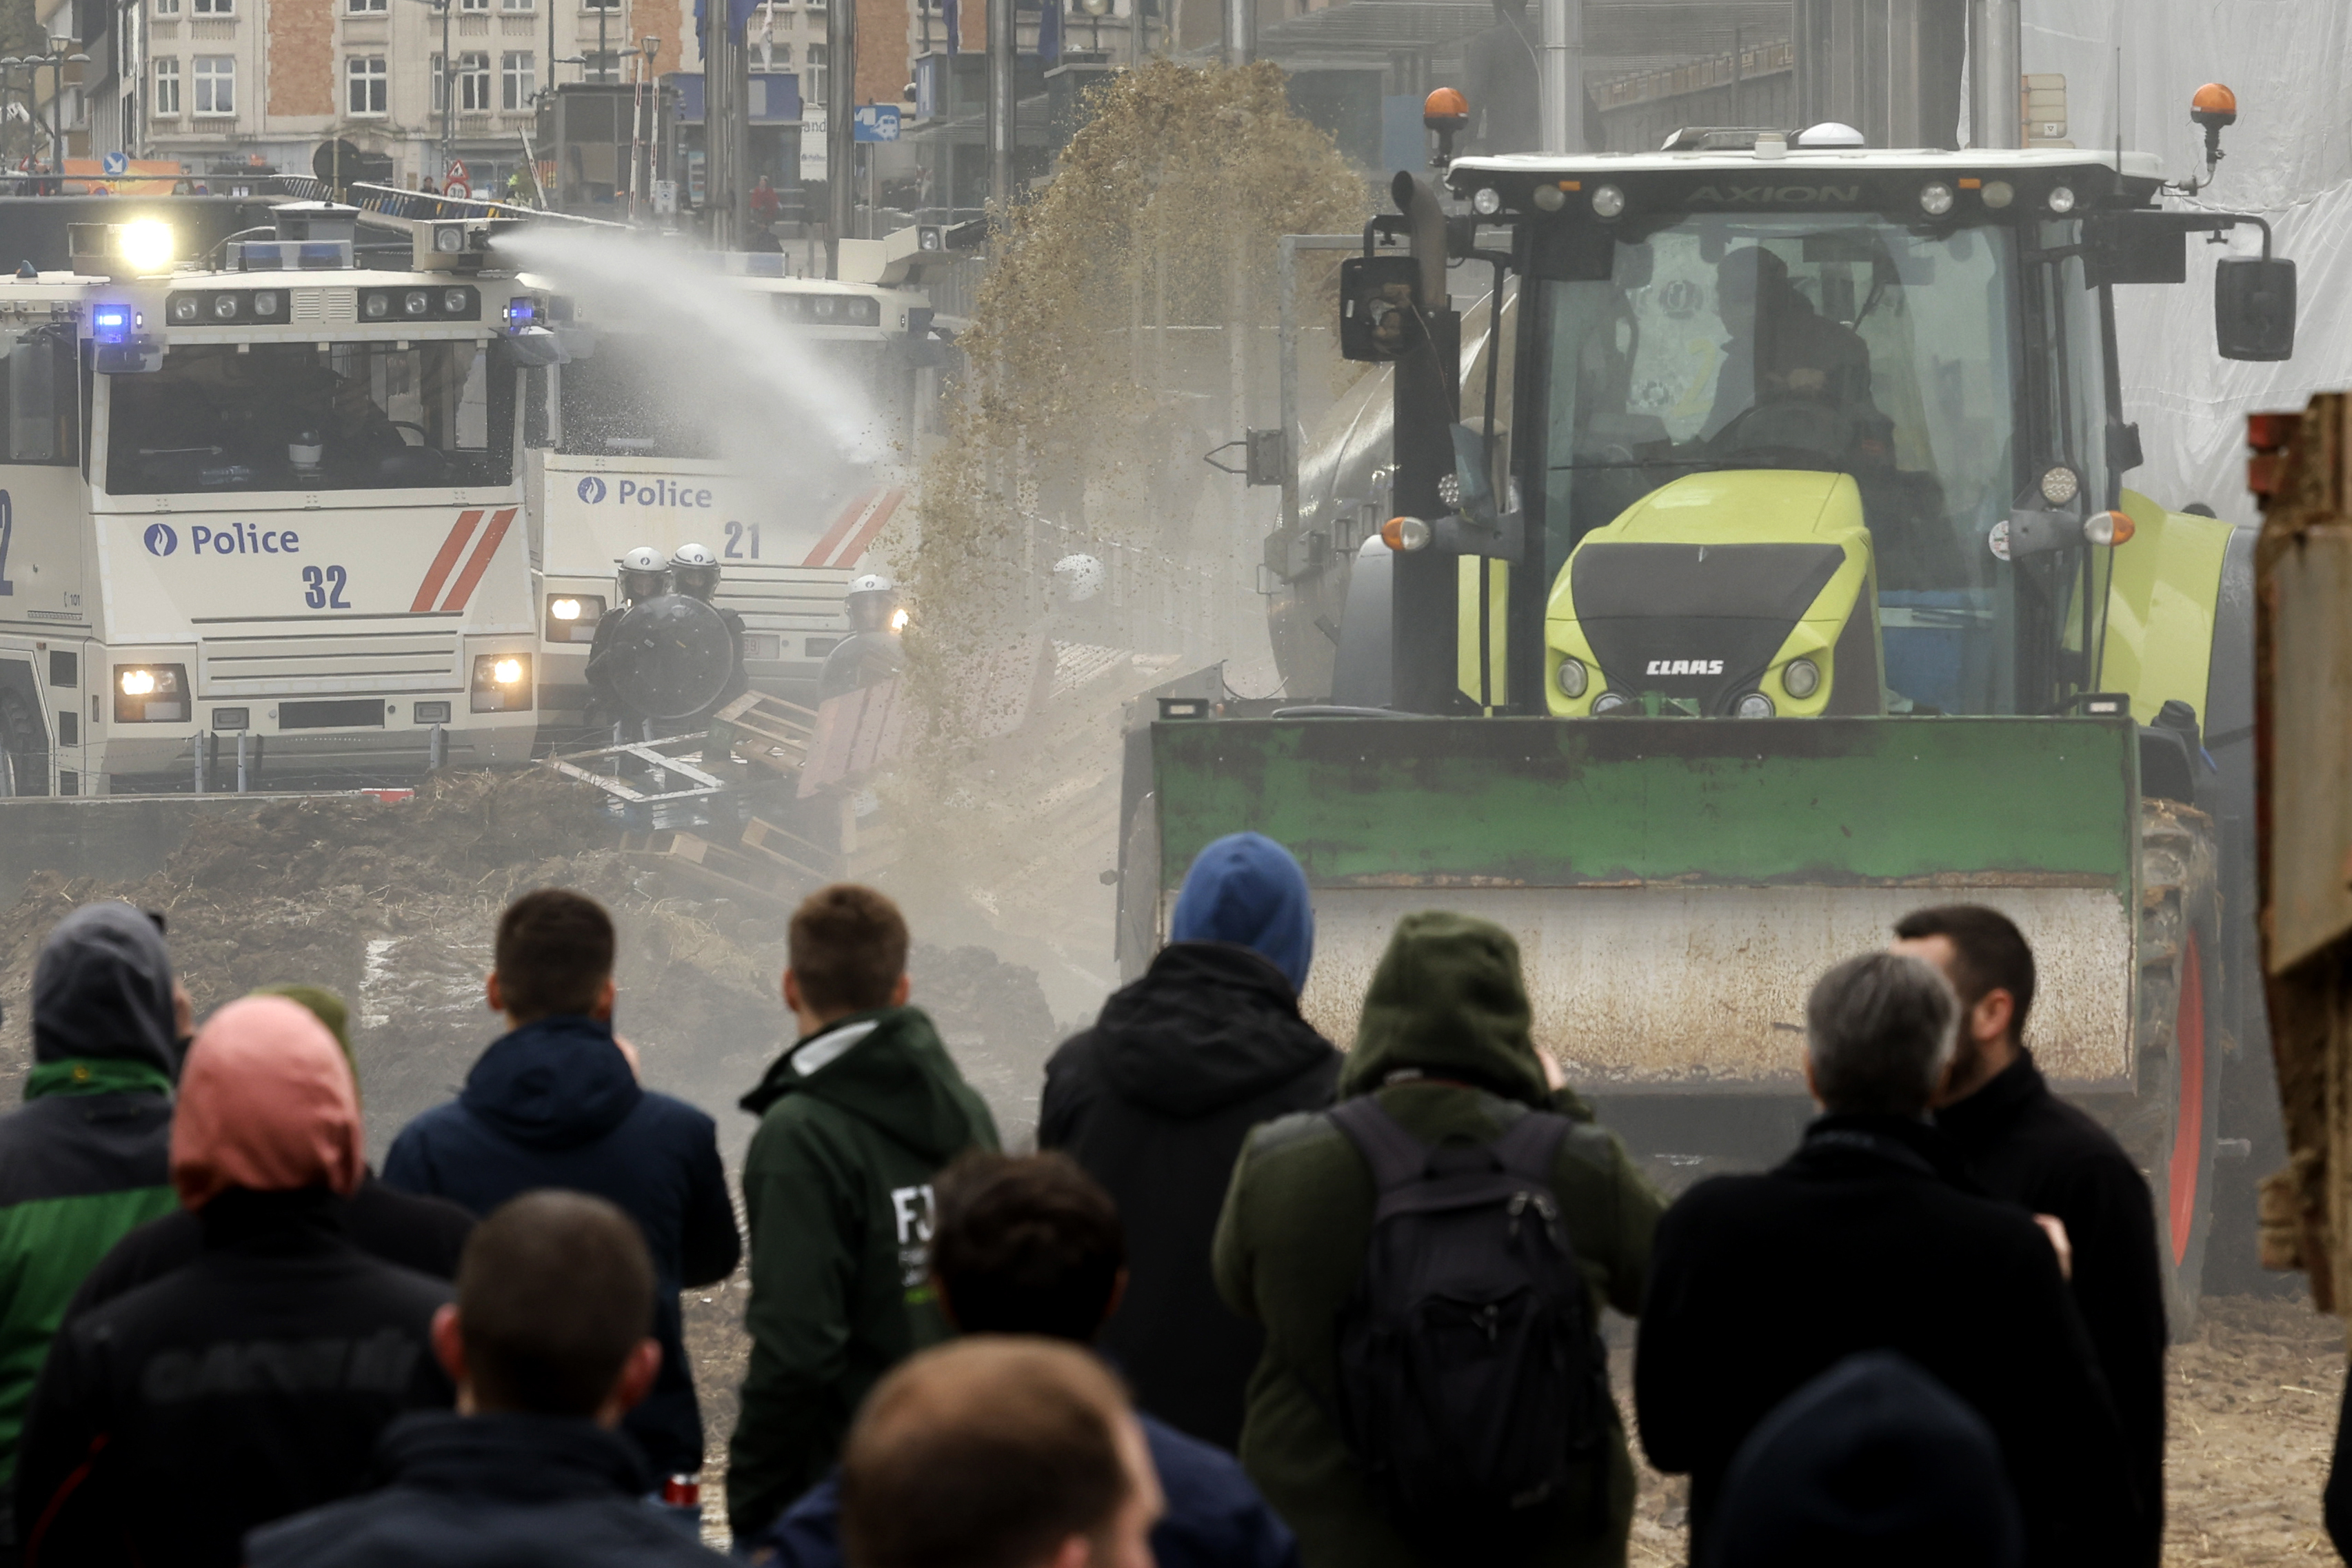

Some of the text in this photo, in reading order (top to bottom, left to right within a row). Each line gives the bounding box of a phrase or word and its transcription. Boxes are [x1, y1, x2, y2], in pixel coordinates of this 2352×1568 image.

[450, 187, 464, 199] 30
[1685, 186, 1859, 202] AXION
[619, 479, 712, 507] Police
[191, 523, 299, 554] Police
[725, 521, 759, 559] 21
[302, 565, 351, 609] 32
[70, 594, 81, 606] 101
[1646, 660, 1724, 675] CLAAS
